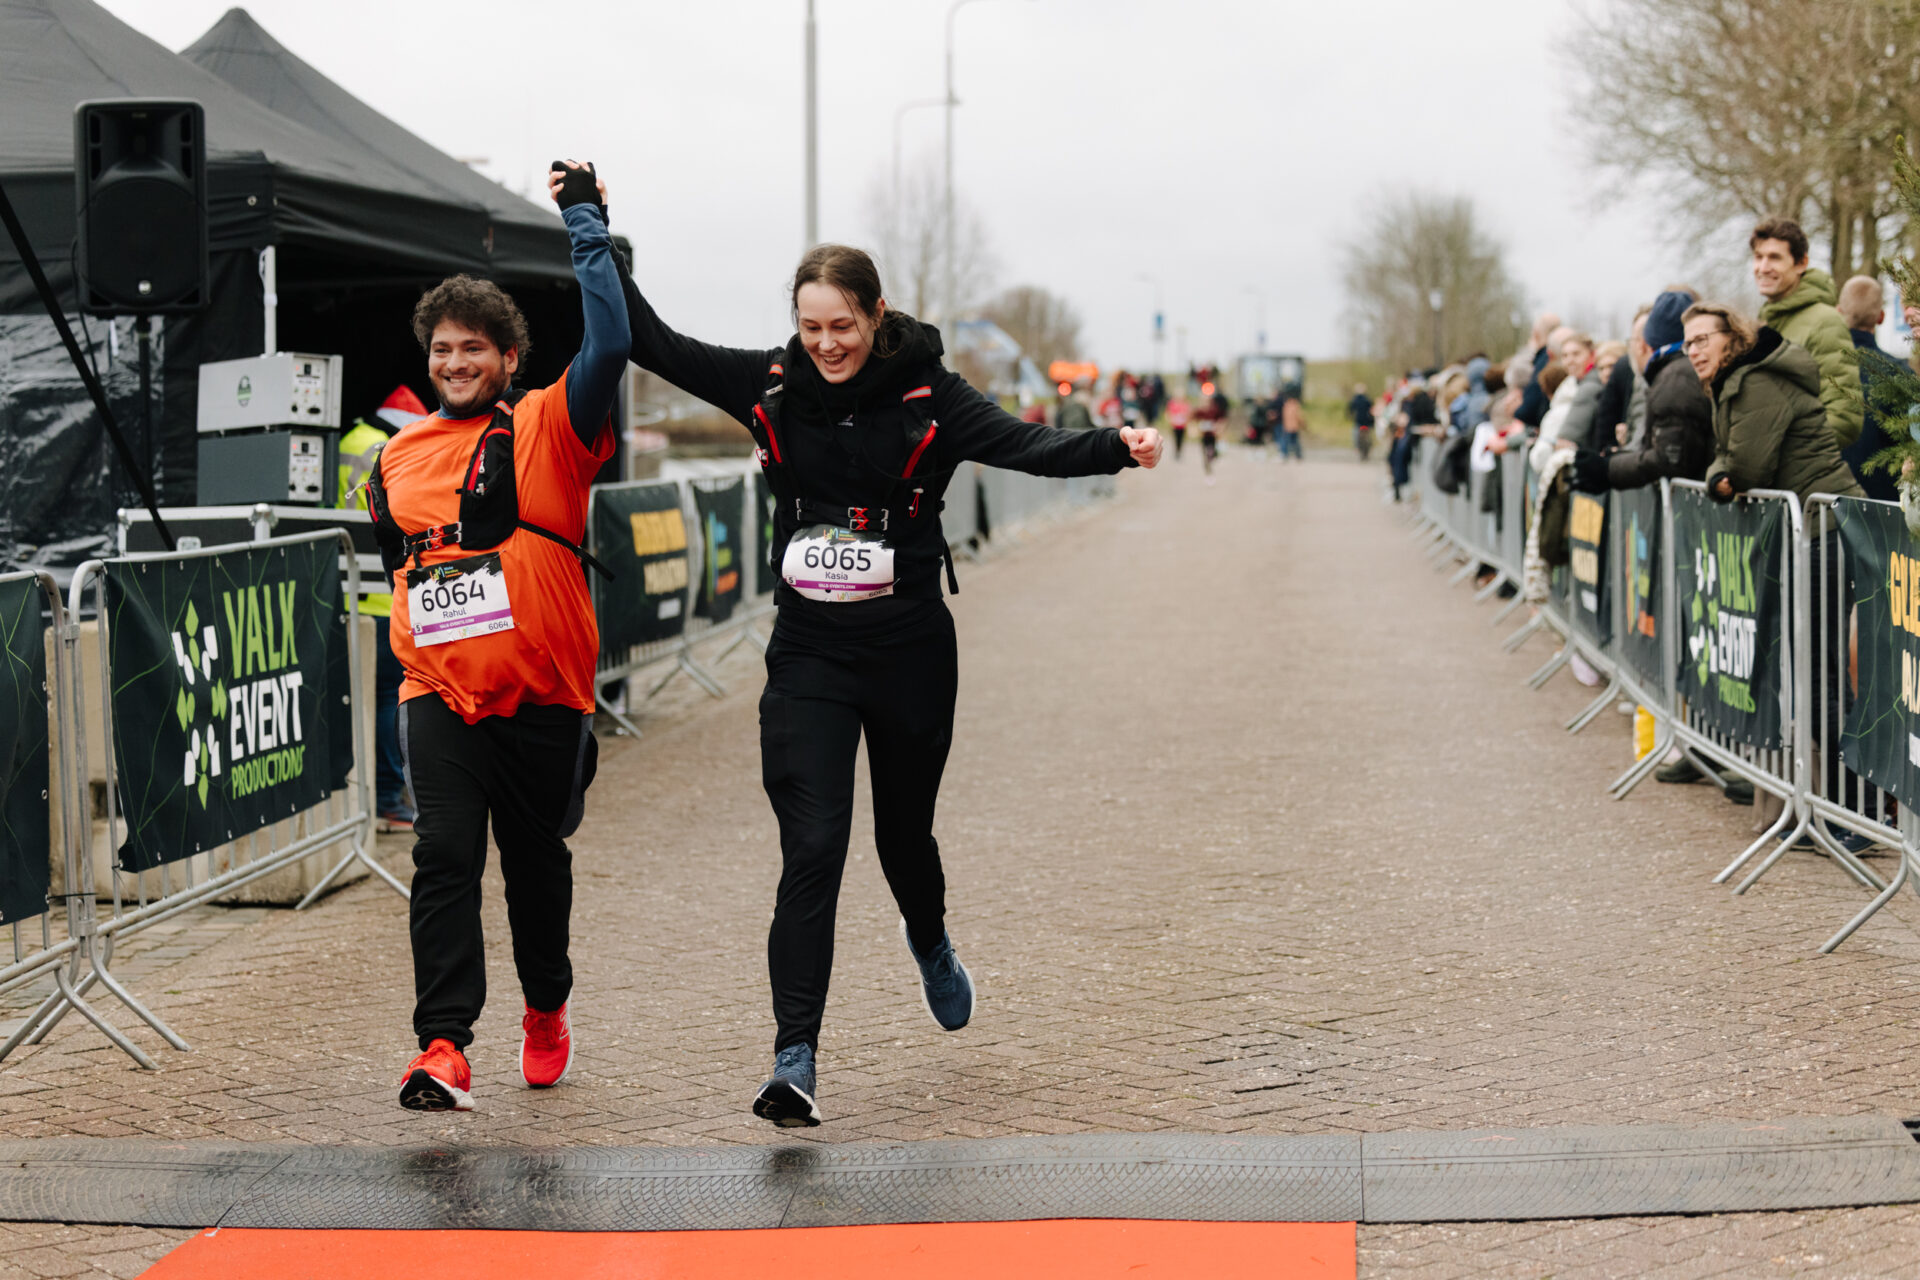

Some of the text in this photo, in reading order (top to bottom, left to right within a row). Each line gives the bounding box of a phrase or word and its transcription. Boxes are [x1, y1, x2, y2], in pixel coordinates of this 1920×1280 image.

[804, 546, 872, 571] 6065
[825, 571, 849, 580] Kasia
[421, 580, 485, 612] 6064
[868, 588, 888, 597] 6065
[442, 607, 467, 618] Rahul
[488, 621, 509, 631] 6064
[223, 580, 299, 679] VALX
[1718, 610, 1757, 679] EVENT
[229, 671, 303, 761] EVENT
[231, 744, 306, 800] PRODUCTIONS
